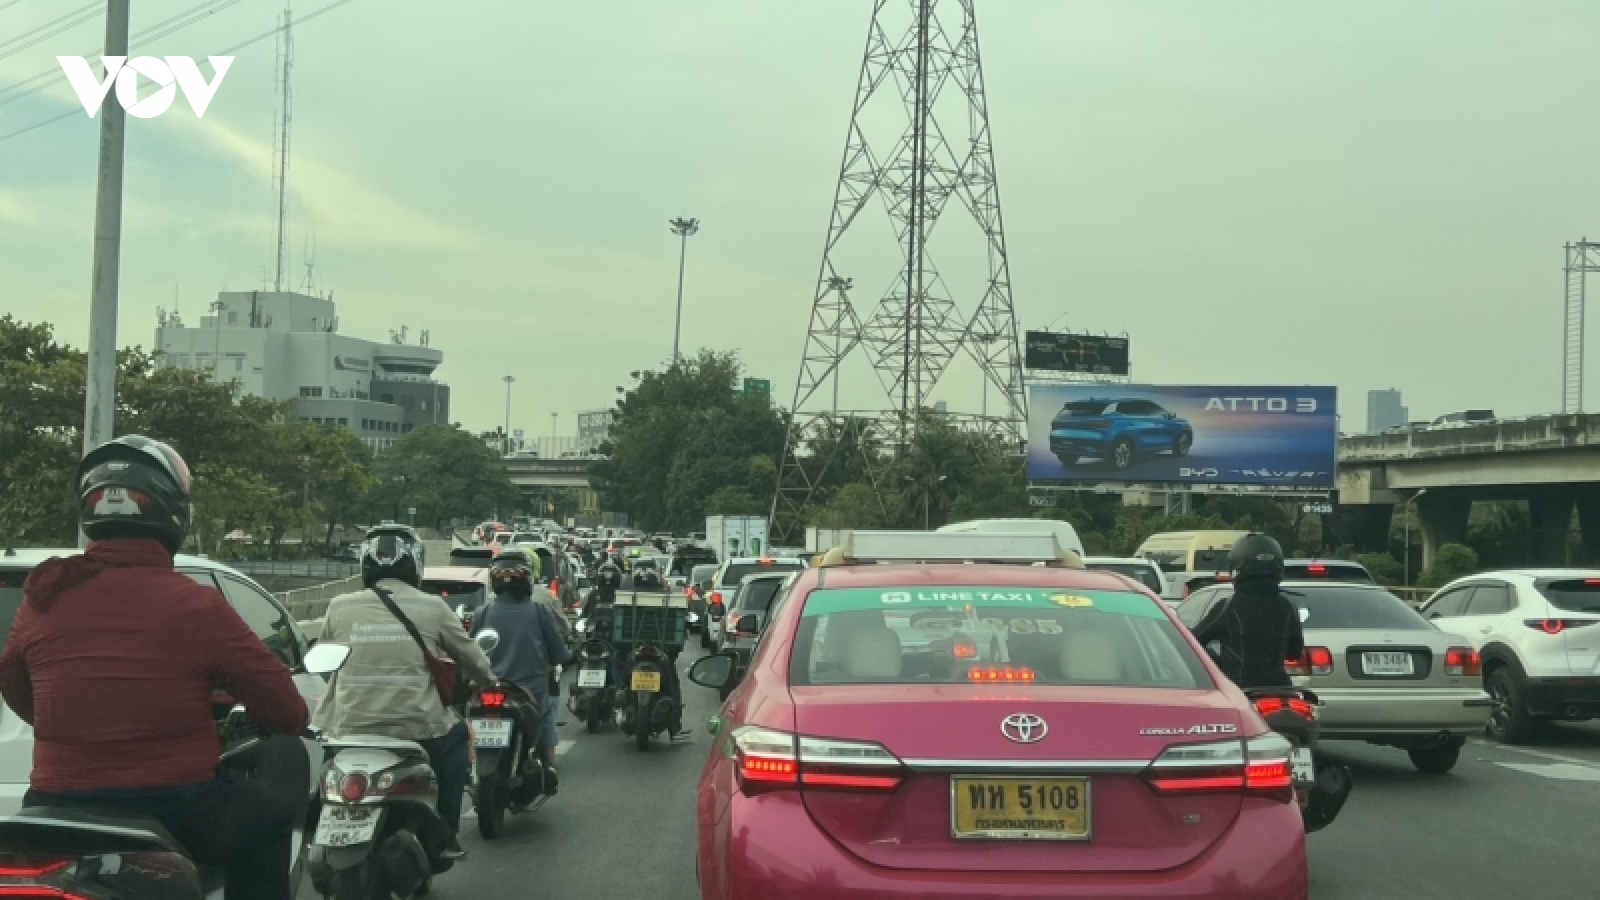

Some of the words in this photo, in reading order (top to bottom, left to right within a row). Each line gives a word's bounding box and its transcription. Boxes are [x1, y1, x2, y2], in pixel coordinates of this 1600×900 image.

[1205, 397, 1288, 413] ATTO
[1296, 397, 1317, 413] 3
[1179, 467, 1219, 477] BYD
[917, 591, 974, 601] LINE
[978, 591, 1033, 602] TAXI
[1139, 727, 1185, 735] COROLLA
[1187, 723, 1237, 735] ALTIS
[1017, 784, 1080, 810] 5108
